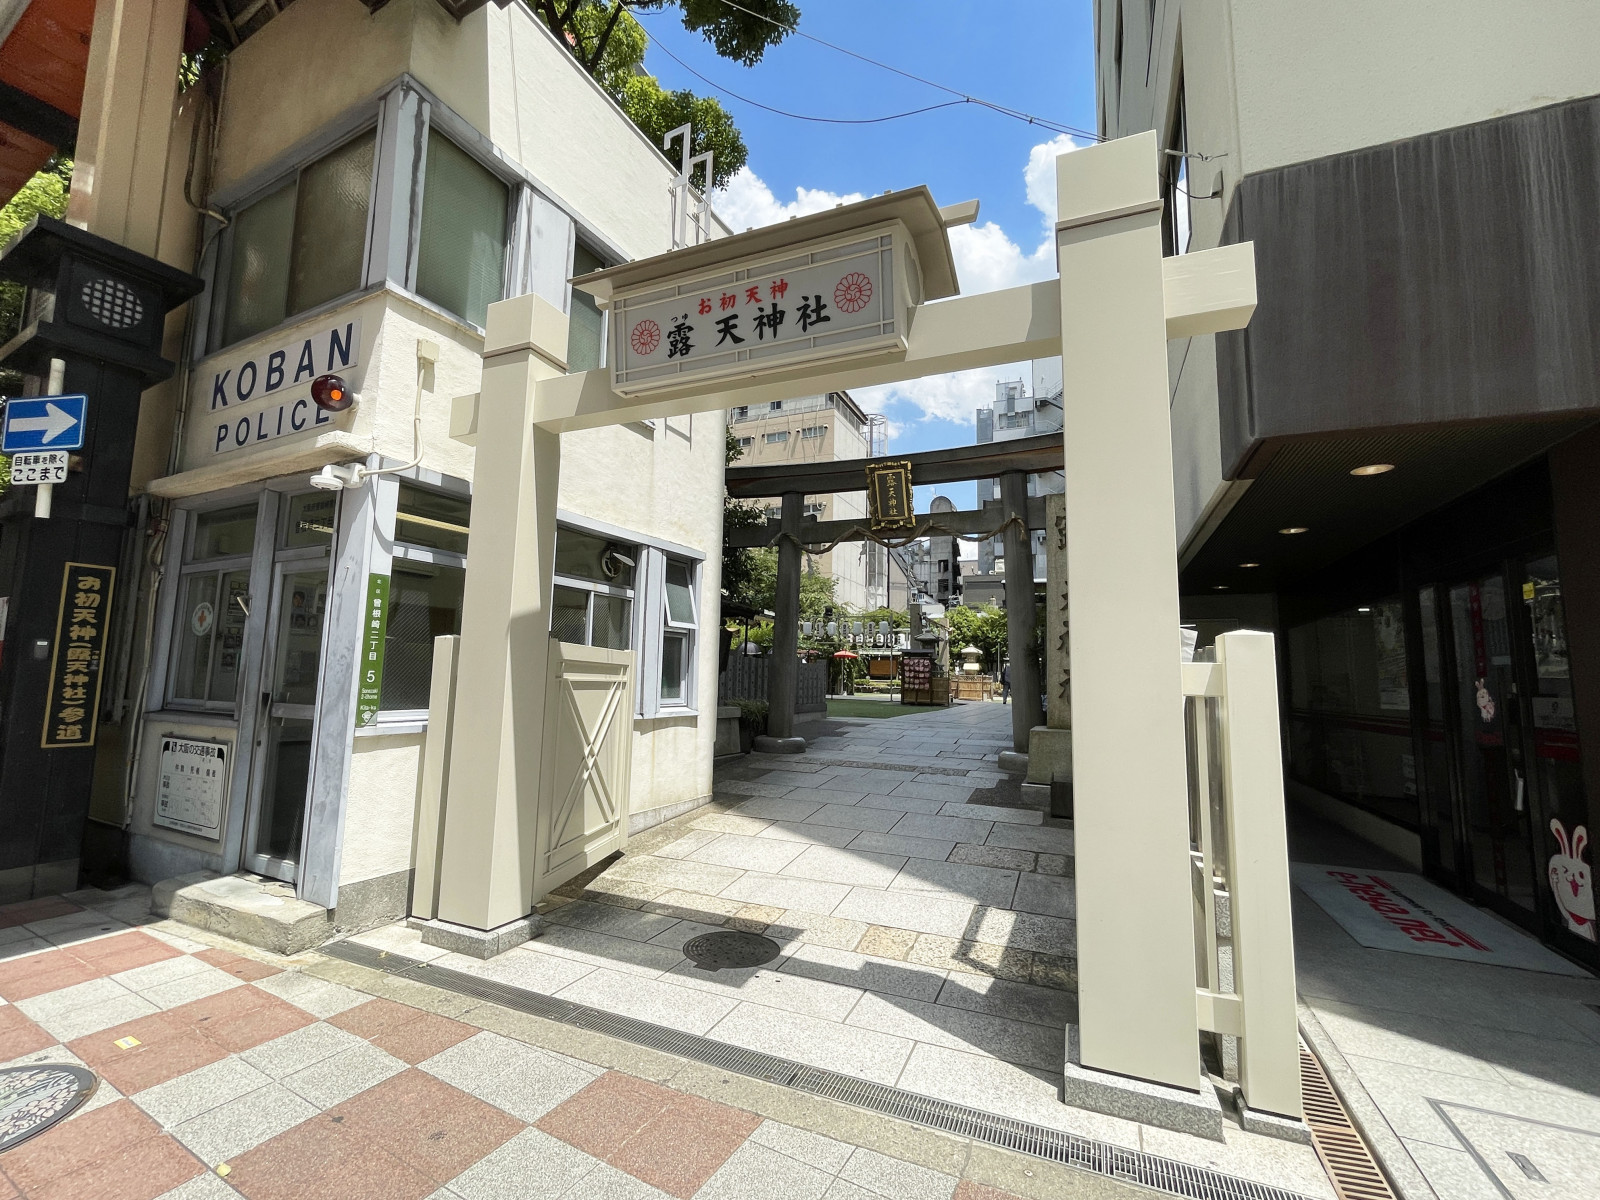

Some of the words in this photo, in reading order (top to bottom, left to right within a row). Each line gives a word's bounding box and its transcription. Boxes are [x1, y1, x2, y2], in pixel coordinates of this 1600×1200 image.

[698, 278, 788, 315] お初天神
[667, 294, 831, 359] 露天神社
[671, 313, 689, 323] つゆ
[211, 322, 353, 410] KOBAN
[215, 399, 330, 452] POLICE
[12, 466, 65, 482] ここまで
[14, 454, 65, 466] 自転車を除く
[366, 670, 376, 683] 5
[1326, 870, 1465, 948] e-heya.net
